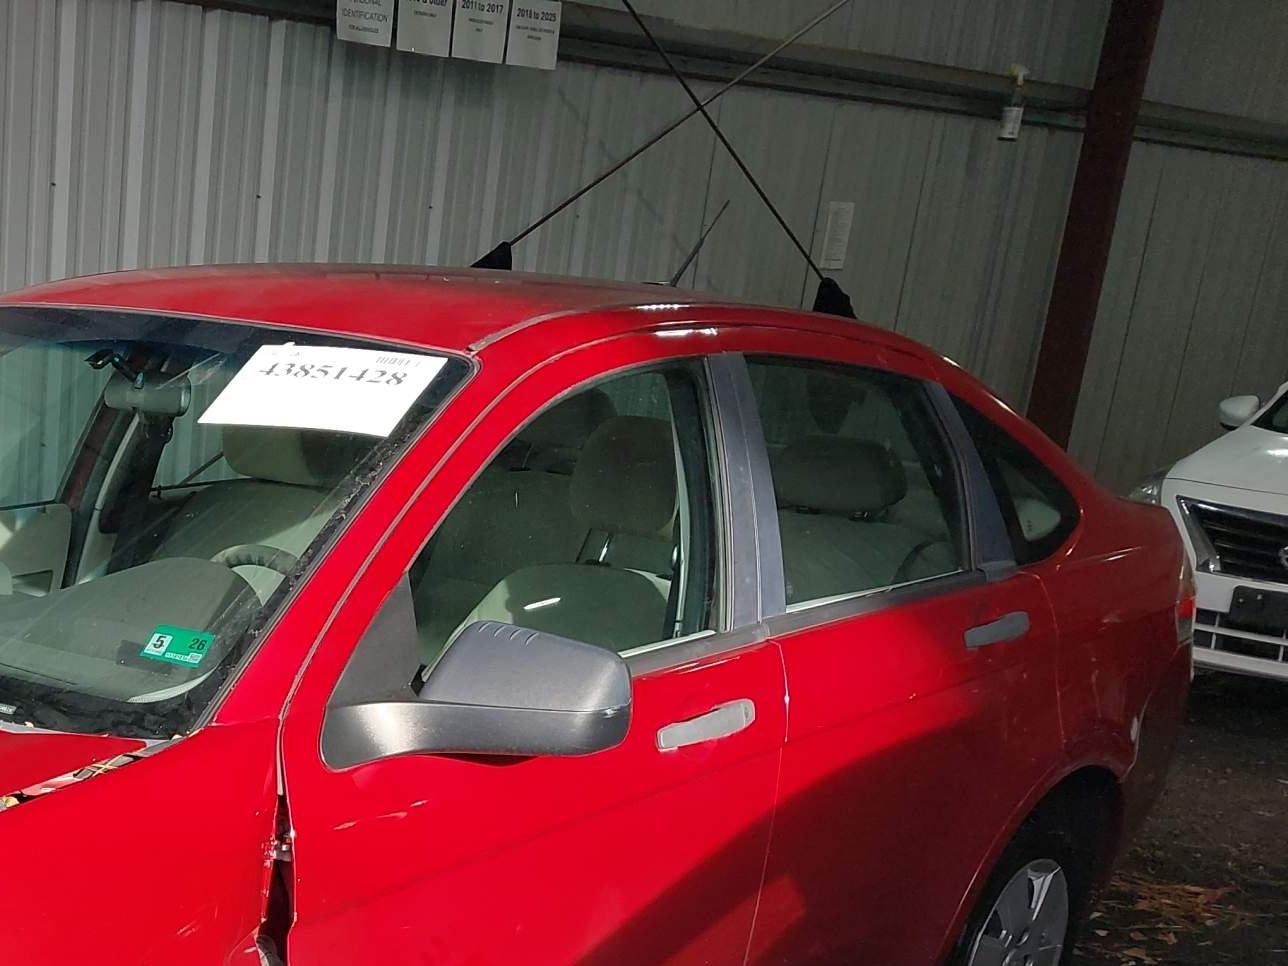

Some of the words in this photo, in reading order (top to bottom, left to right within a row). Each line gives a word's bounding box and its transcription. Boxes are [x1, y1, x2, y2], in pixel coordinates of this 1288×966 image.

[486, 3, 504, 15] 2017
[258, 361, 409, 386] 43851428
[152, 635, 167, 649] 5
[188, 638, 208, 651] 26
